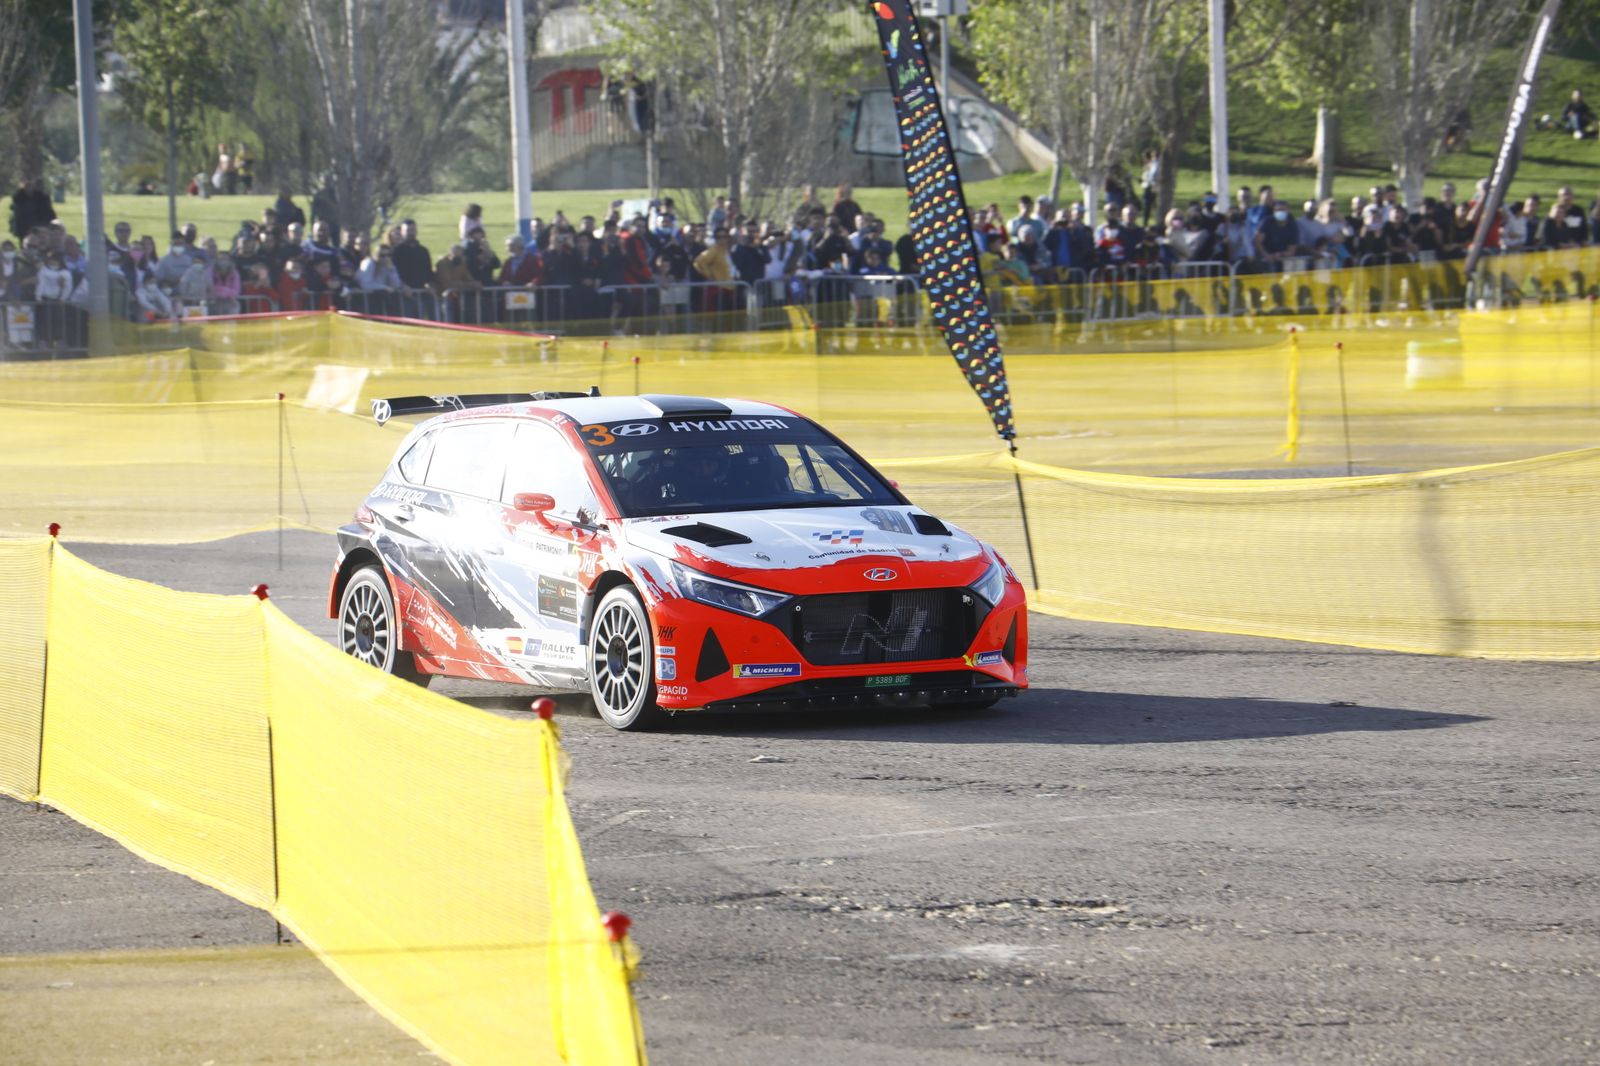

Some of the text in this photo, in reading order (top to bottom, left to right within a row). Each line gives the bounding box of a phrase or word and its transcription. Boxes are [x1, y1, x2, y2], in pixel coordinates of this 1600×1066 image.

[668, 419, 789, 432] HYUNDAI
[581, 424, 616, 446] 3
[808, 548, 855, 560] Comunidad
[542, 642, 576, 654] RALLYE
[867, 676, 873, 685] P
[875, 676, 893, 684] 5389
[663, 685, 688, 695] PAGID
